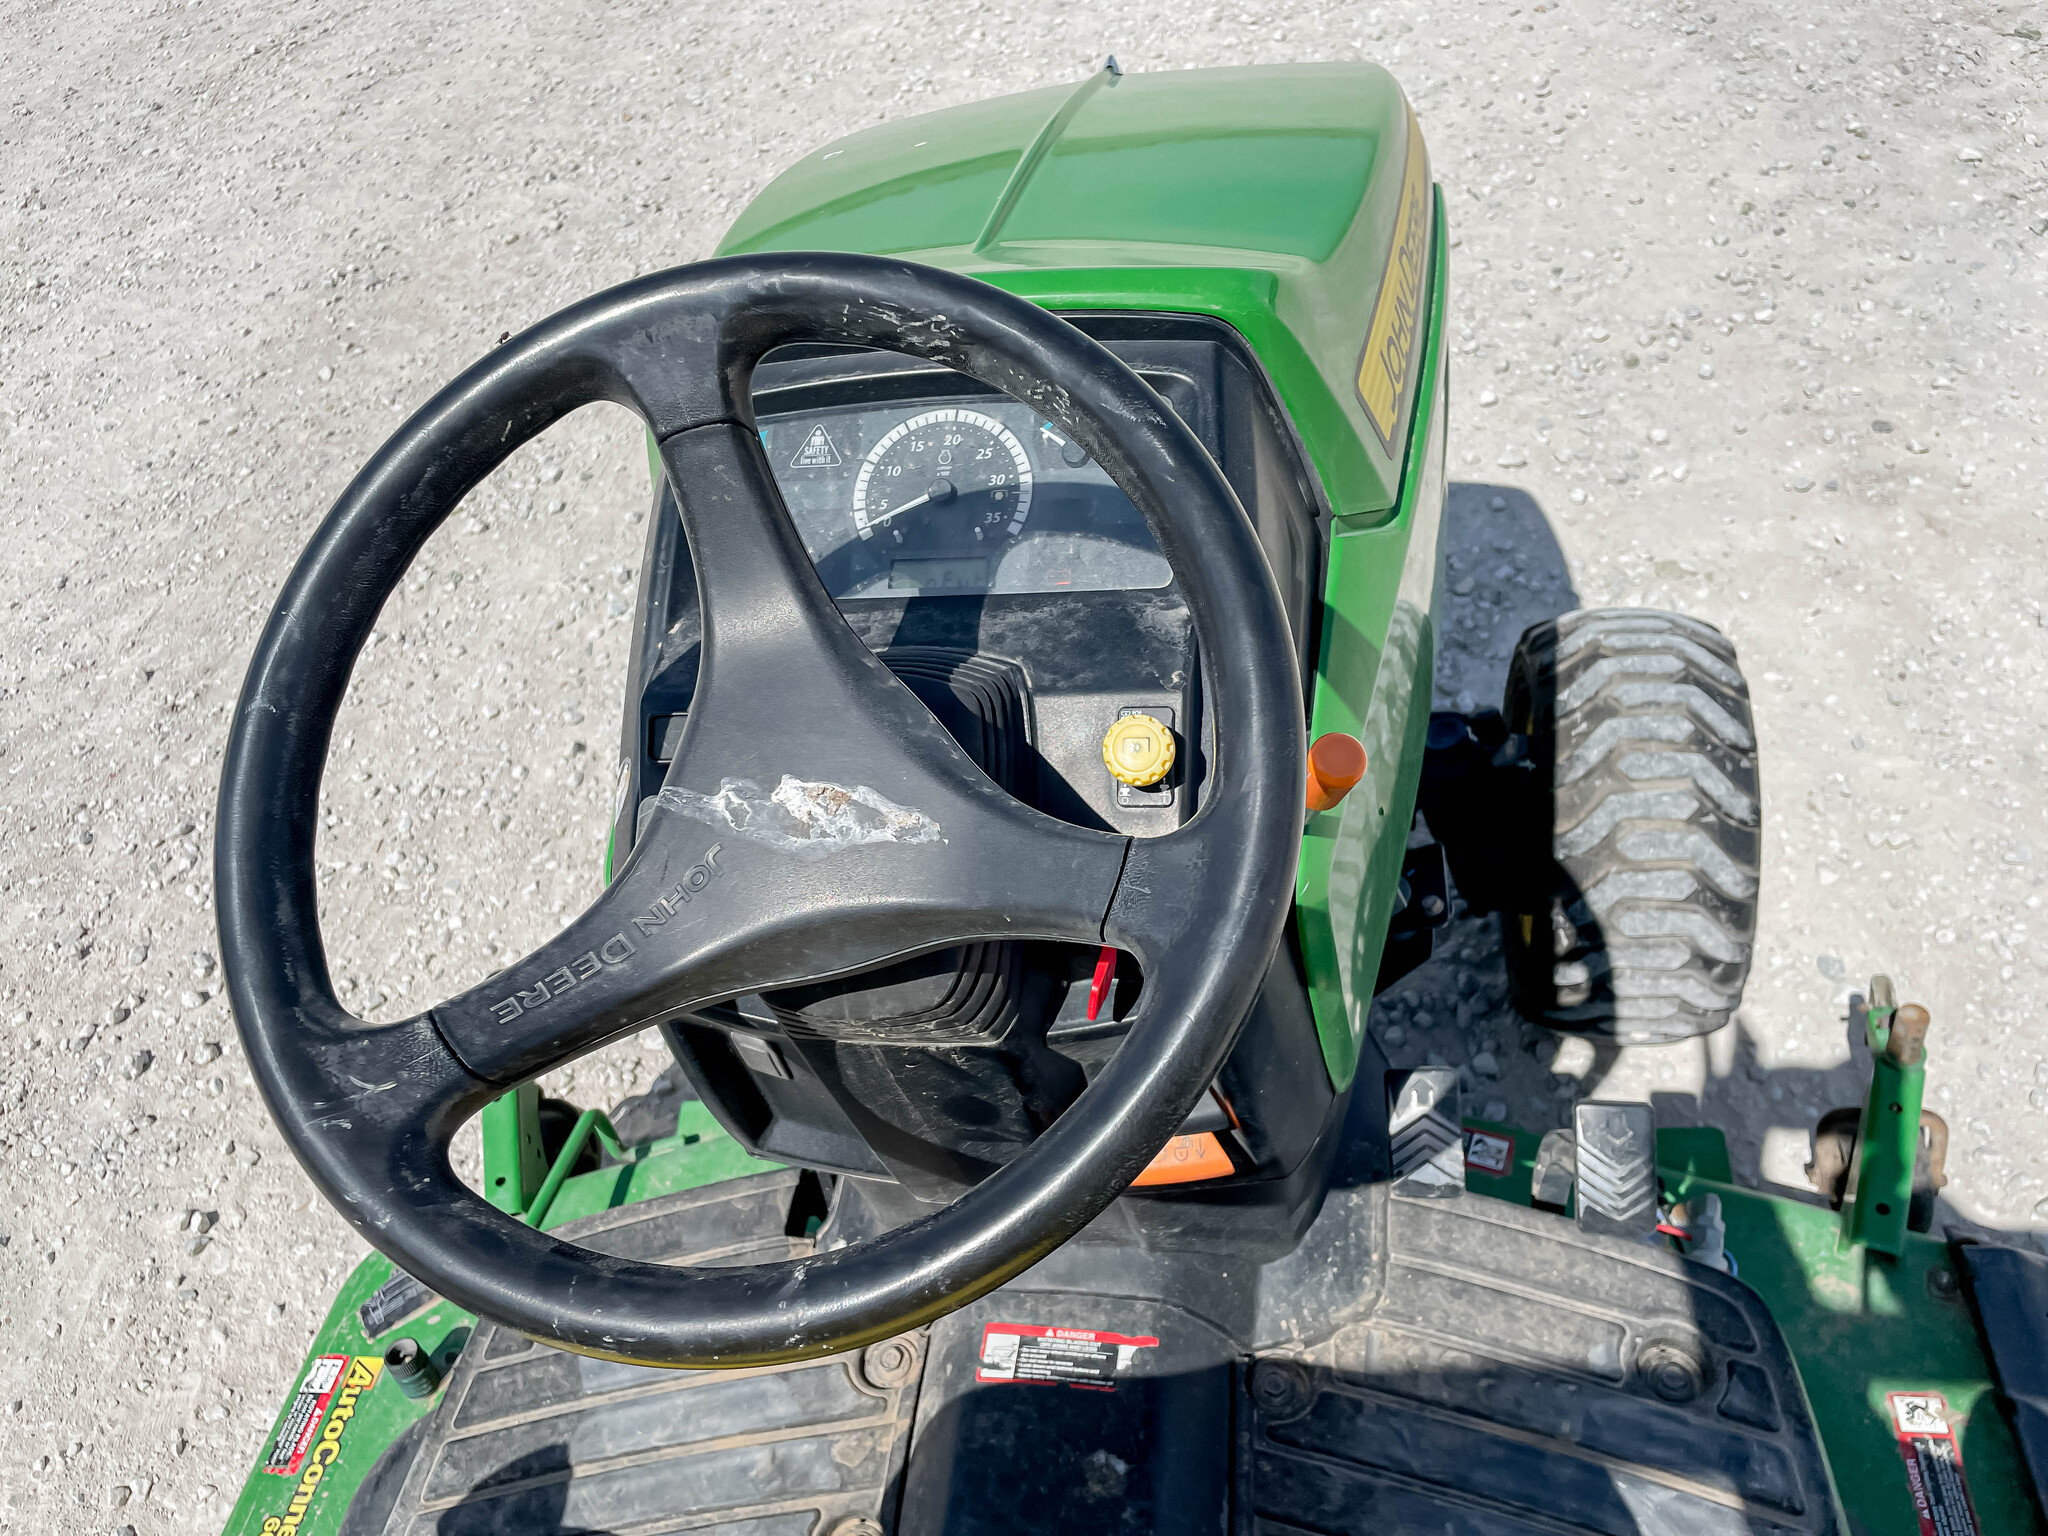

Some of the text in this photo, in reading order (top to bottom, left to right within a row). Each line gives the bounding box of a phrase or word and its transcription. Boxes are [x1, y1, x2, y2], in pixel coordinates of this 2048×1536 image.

[1380, 182, 1423, 414] JOHN DEERE
[943, 434, 961, 446] 20
[804, 446, 830, 456] SAFETY
[910, 441, 925, 452] 15
[975, 448, 993, 460] 25
[886, 465, 902, 477] 10
[988, 474, 1006, 486] 30
[878, 499, 888, 510] 5
[984, 512, 1002, 524] 35
[489, 842, 726, 1025] JOHN DEERE
[1055, 1329, 1096, 1340] DANGER
[296, 1416, 319, 1454] DANGER
[1906, 1458, 1929, 1508] DANGER
